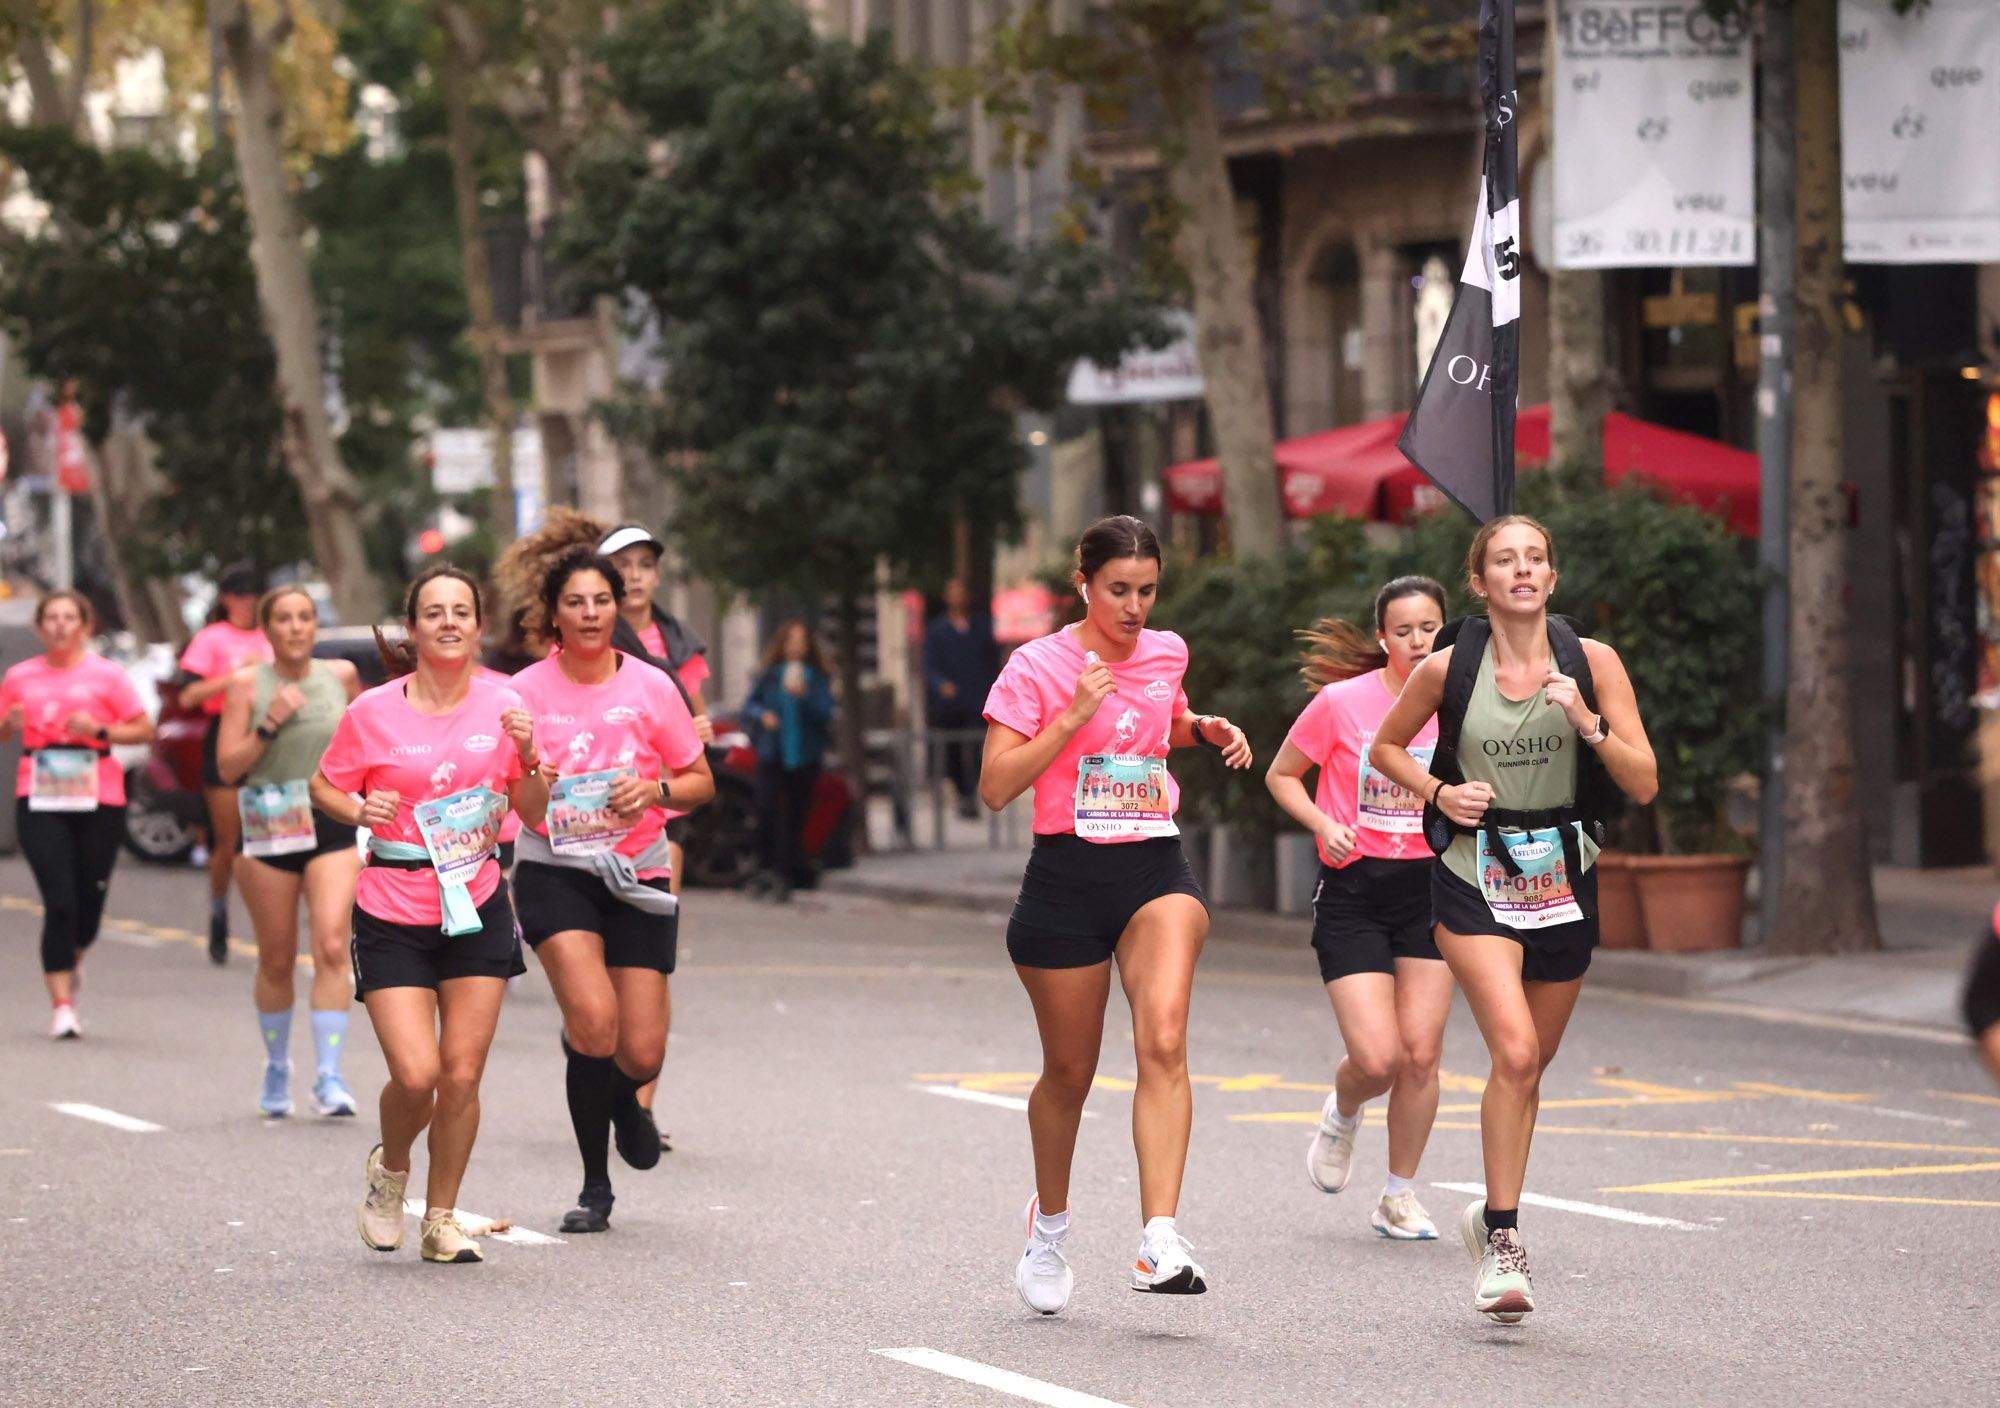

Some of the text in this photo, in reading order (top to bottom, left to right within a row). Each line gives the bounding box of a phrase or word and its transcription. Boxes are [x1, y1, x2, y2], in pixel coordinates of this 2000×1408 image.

[1483, 735, 1562, 756] OYSHO
[1497, 758, 1549, 768] RUNNING CLUB
[1112, 782, 1148, 799] 016
[1121, 802, 1139, 810] 3072
[459, 823, 491, 845] 016
[1514, 872, 1552, 892] 016
[1523, 894, 1543, 902] 9082
